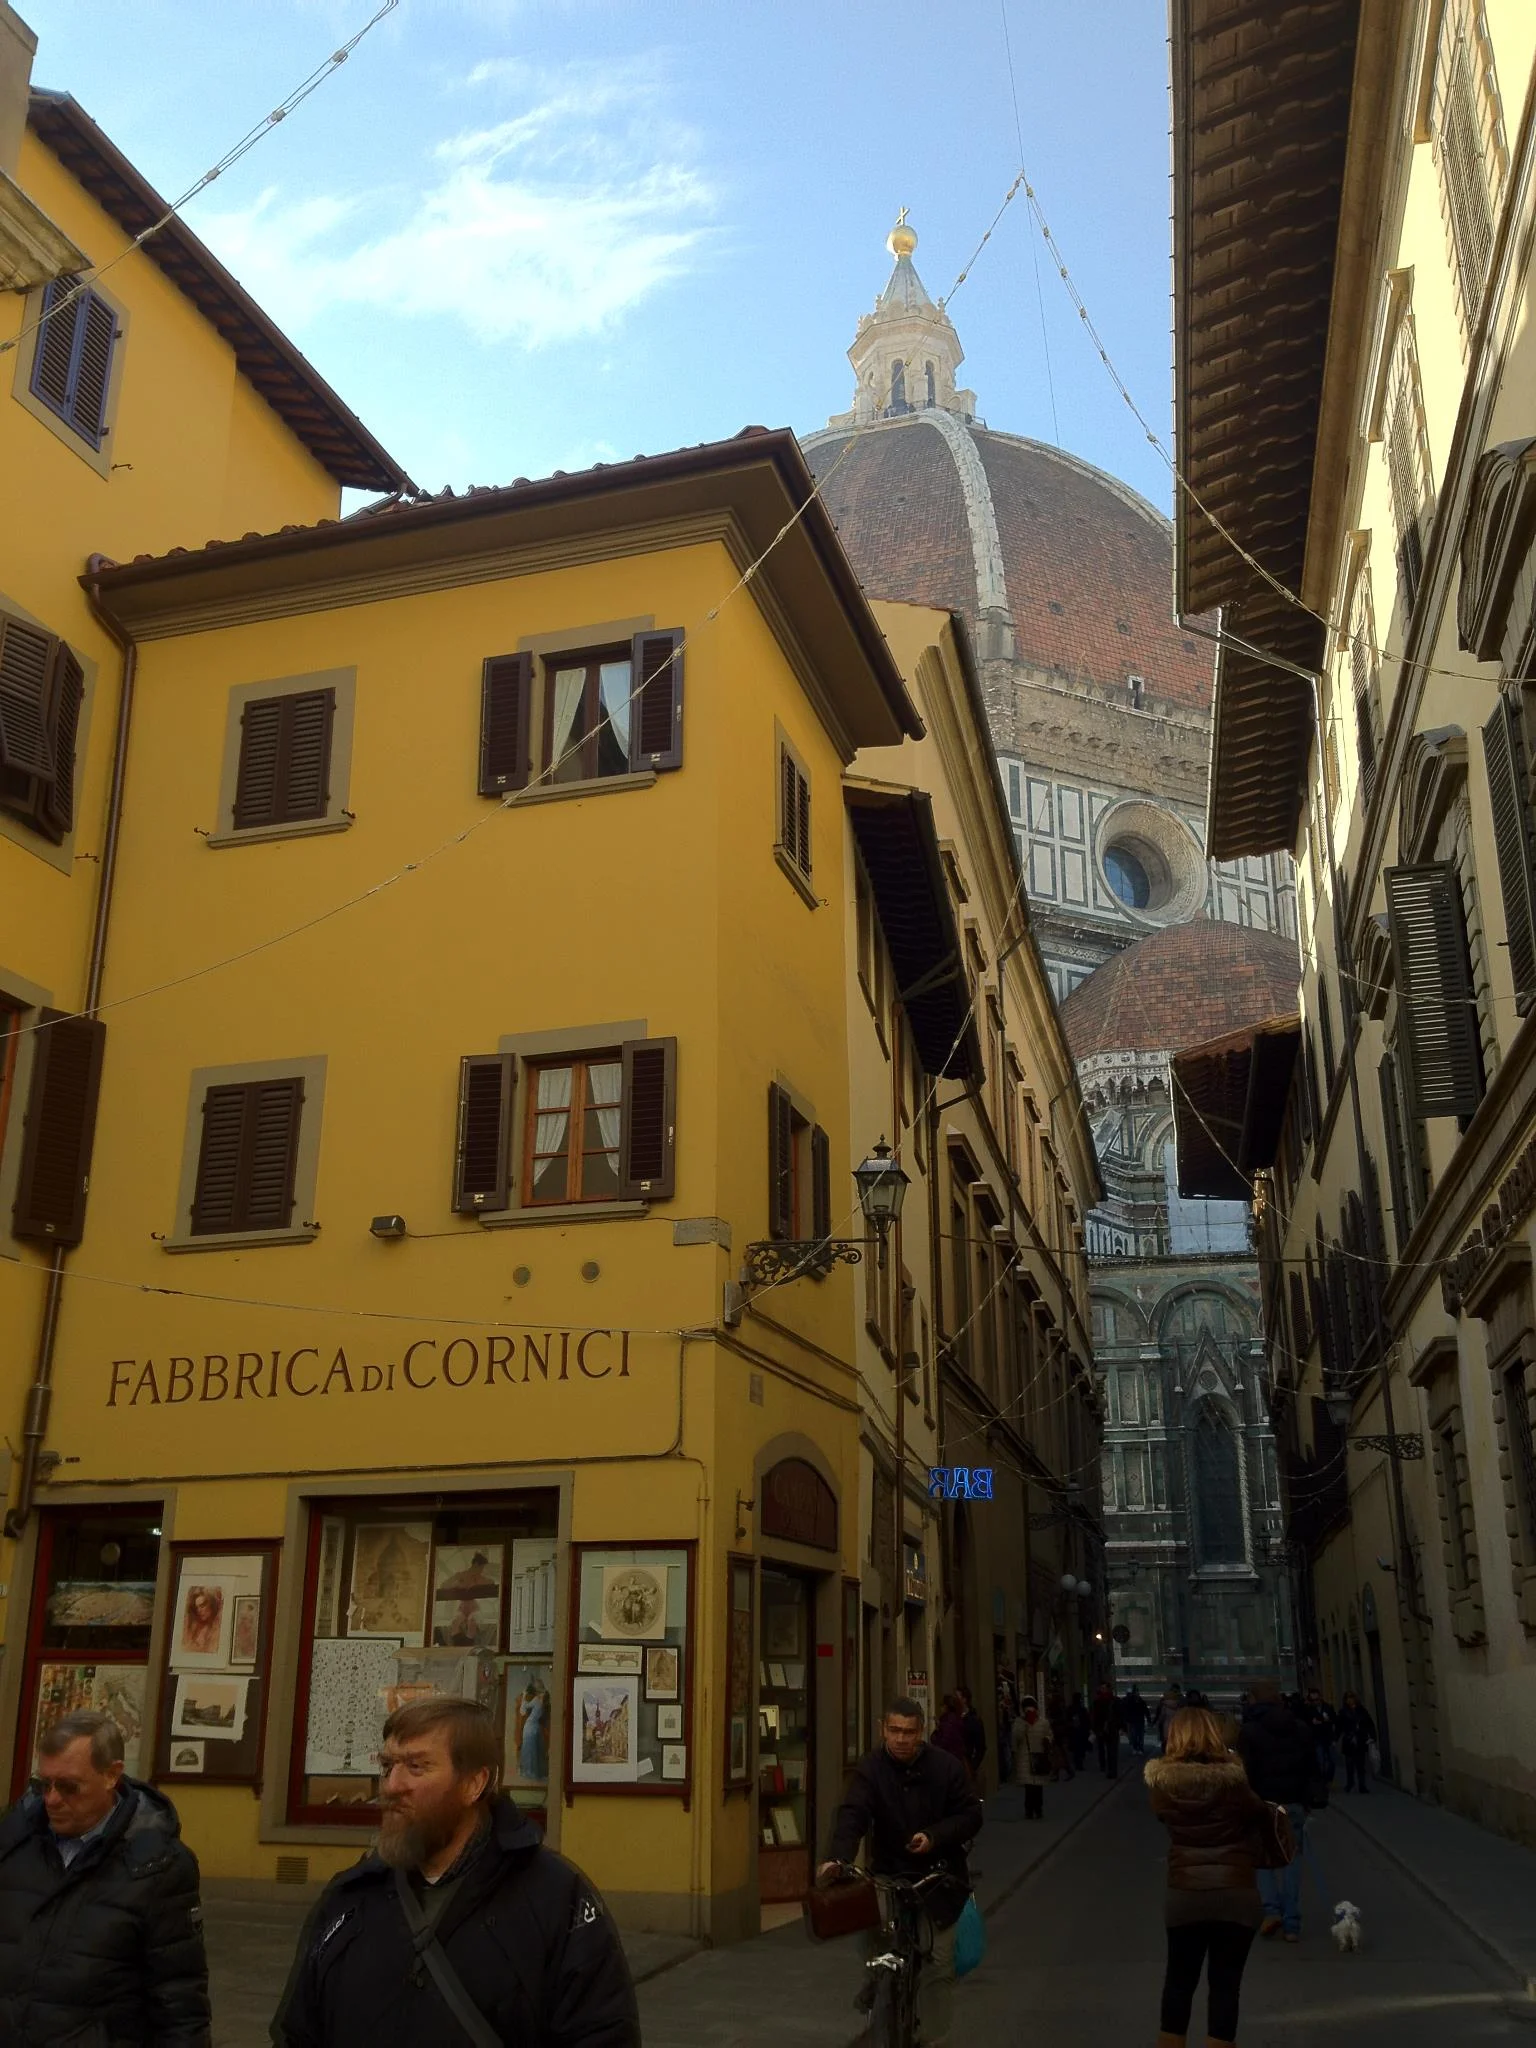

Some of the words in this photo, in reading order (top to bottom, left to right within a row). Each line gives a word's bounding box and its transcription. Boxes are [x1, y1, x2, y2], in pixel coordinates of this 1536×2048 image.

[105, 1346, 354, 1407] FABBRICA
[361, 1364, 395, 1392] DI
[403, 1329, 631, 1389] CORNICI
